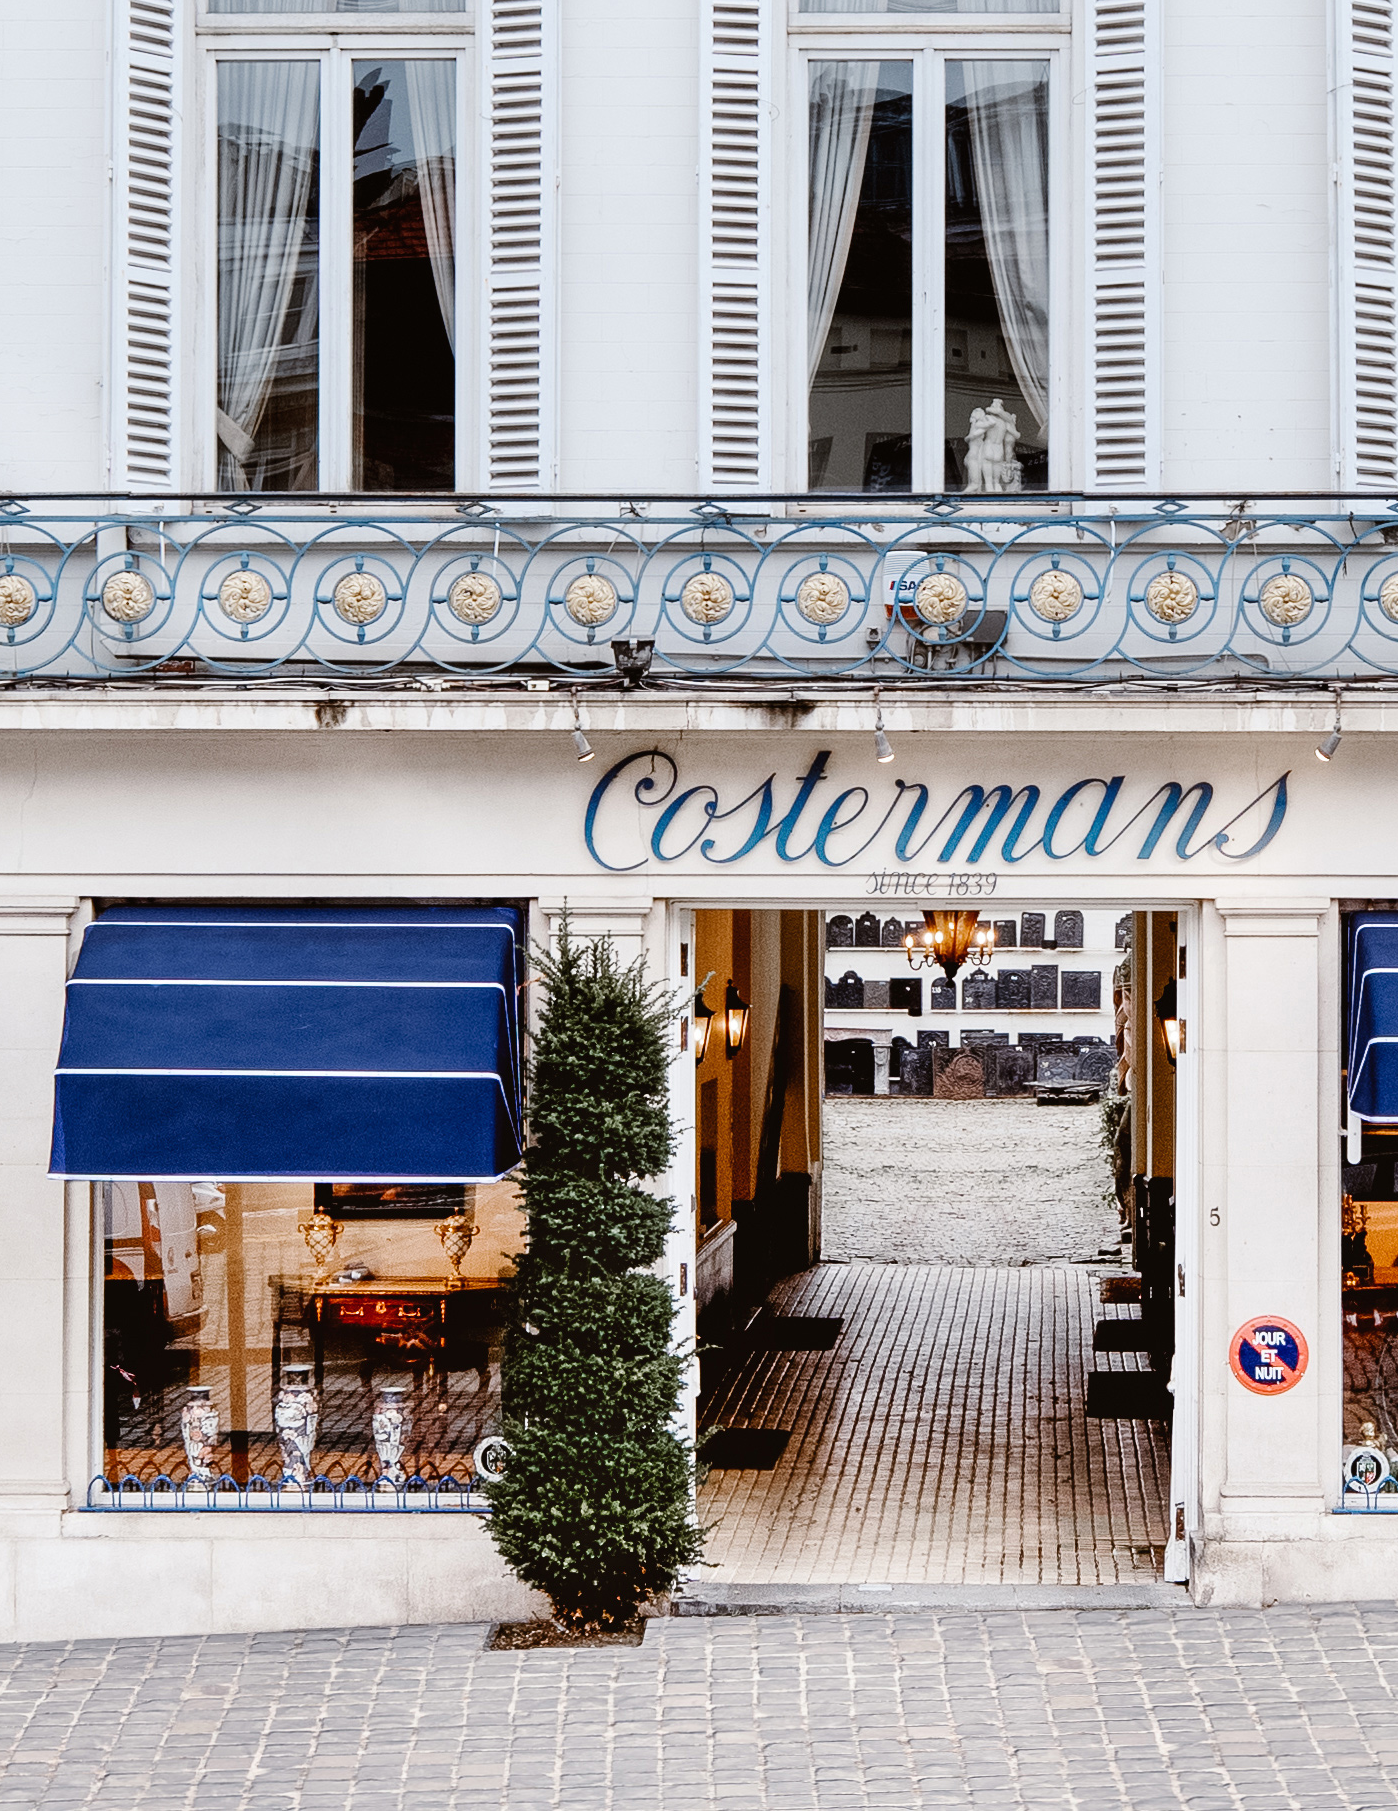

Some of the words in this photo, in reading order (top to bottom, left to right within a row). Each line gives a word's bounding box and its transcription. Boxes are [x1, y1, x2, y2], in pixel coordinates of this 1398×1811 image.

[584, 750, 1293, 872] Costermans
[865, 867, 940, 896] since
[948, 872, 998, 896] 1839
[1209, 1206, 1221, 1227] 5
[1252, 1331, 1286, 1346] JOUR
[1260, 1349, 1278, 1363] ET
[1254, 1366, 1285, 1381] NUIT
